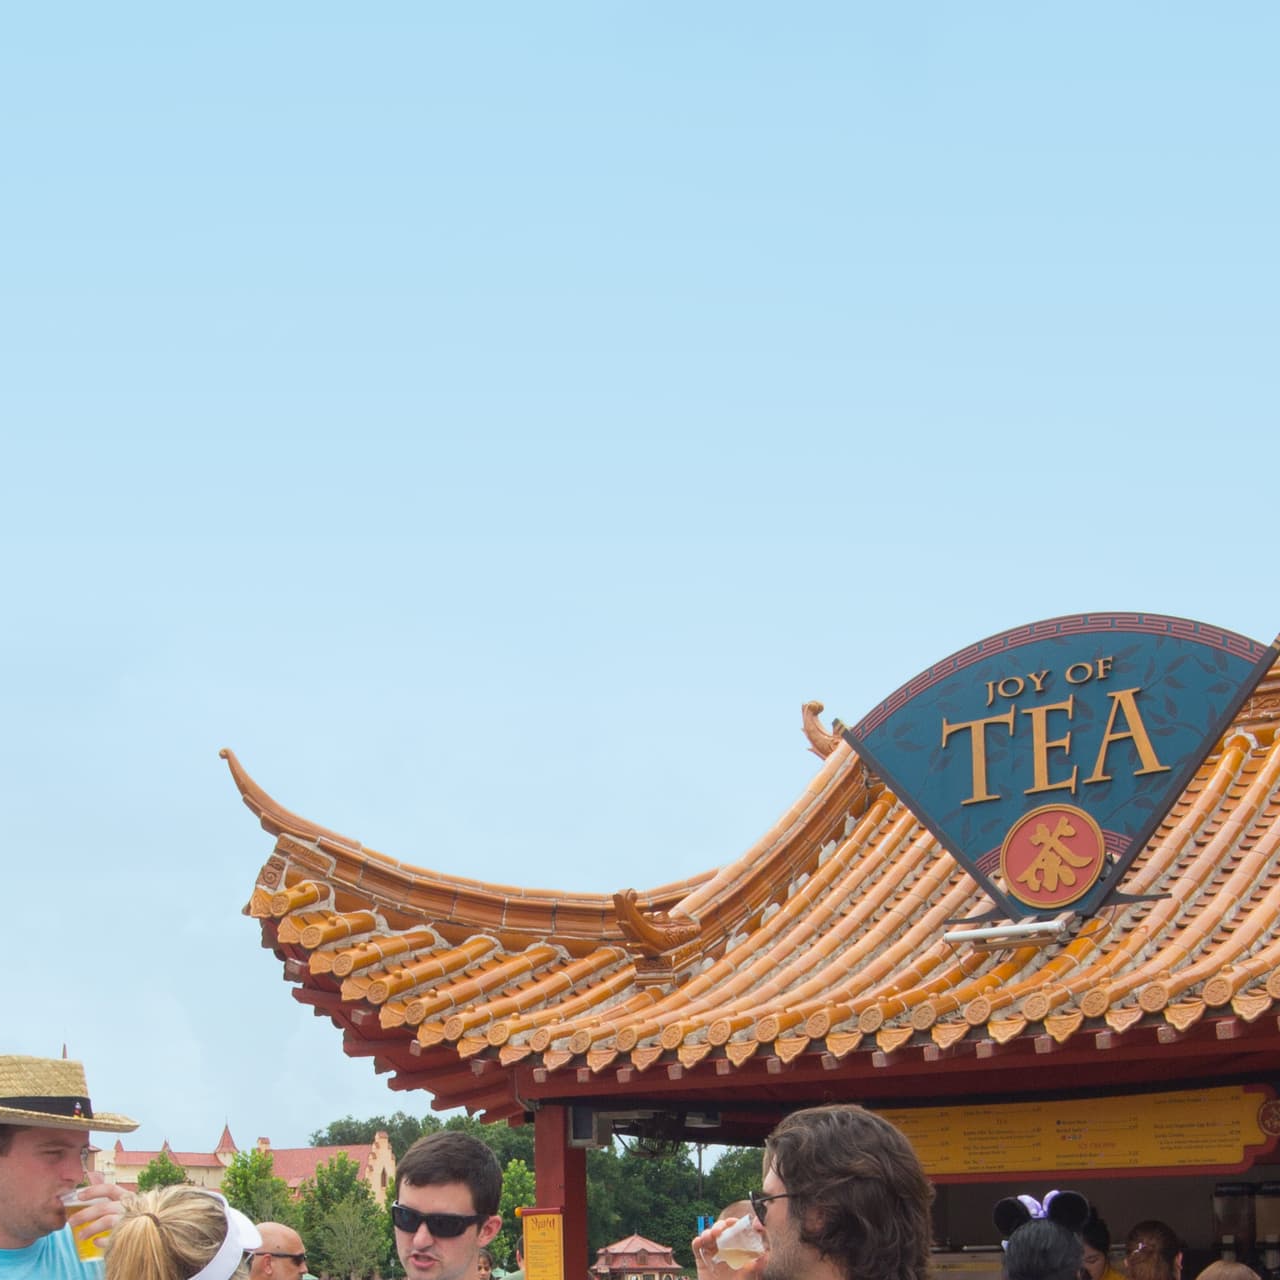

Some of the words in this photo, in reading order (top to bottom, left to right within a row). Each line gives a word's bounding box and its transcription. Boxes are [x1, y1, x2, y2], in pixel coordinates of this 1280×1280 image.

[985, 671, 1049, 706] JOY
[1065, 656, 1113, 685] OF
[942, 687, 1172, 806] TEA
[1016, 815, 1094, 893] 茶
